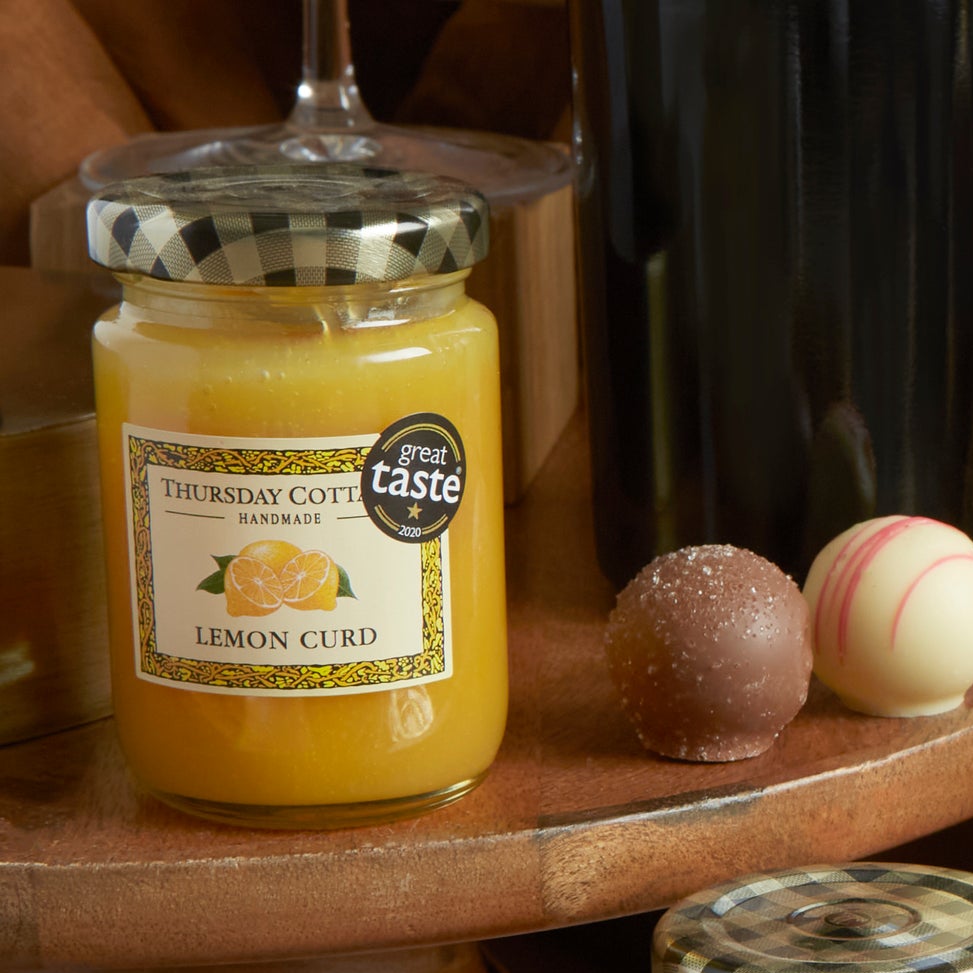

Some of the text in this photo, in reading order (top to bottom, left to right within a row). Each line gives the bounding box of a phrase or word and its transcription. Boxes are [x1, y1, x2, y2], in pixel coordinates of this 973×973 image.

[400, 442, 448, 466] great
[161, 478, 362, 506] THURSDAY COTT
[371, 460, 461, 504] taste
[238, 512, 322, 525] HANDMADE
[398, 524, 422, 538] 2020
[195, 626, 377, 650] LEMON CURD
